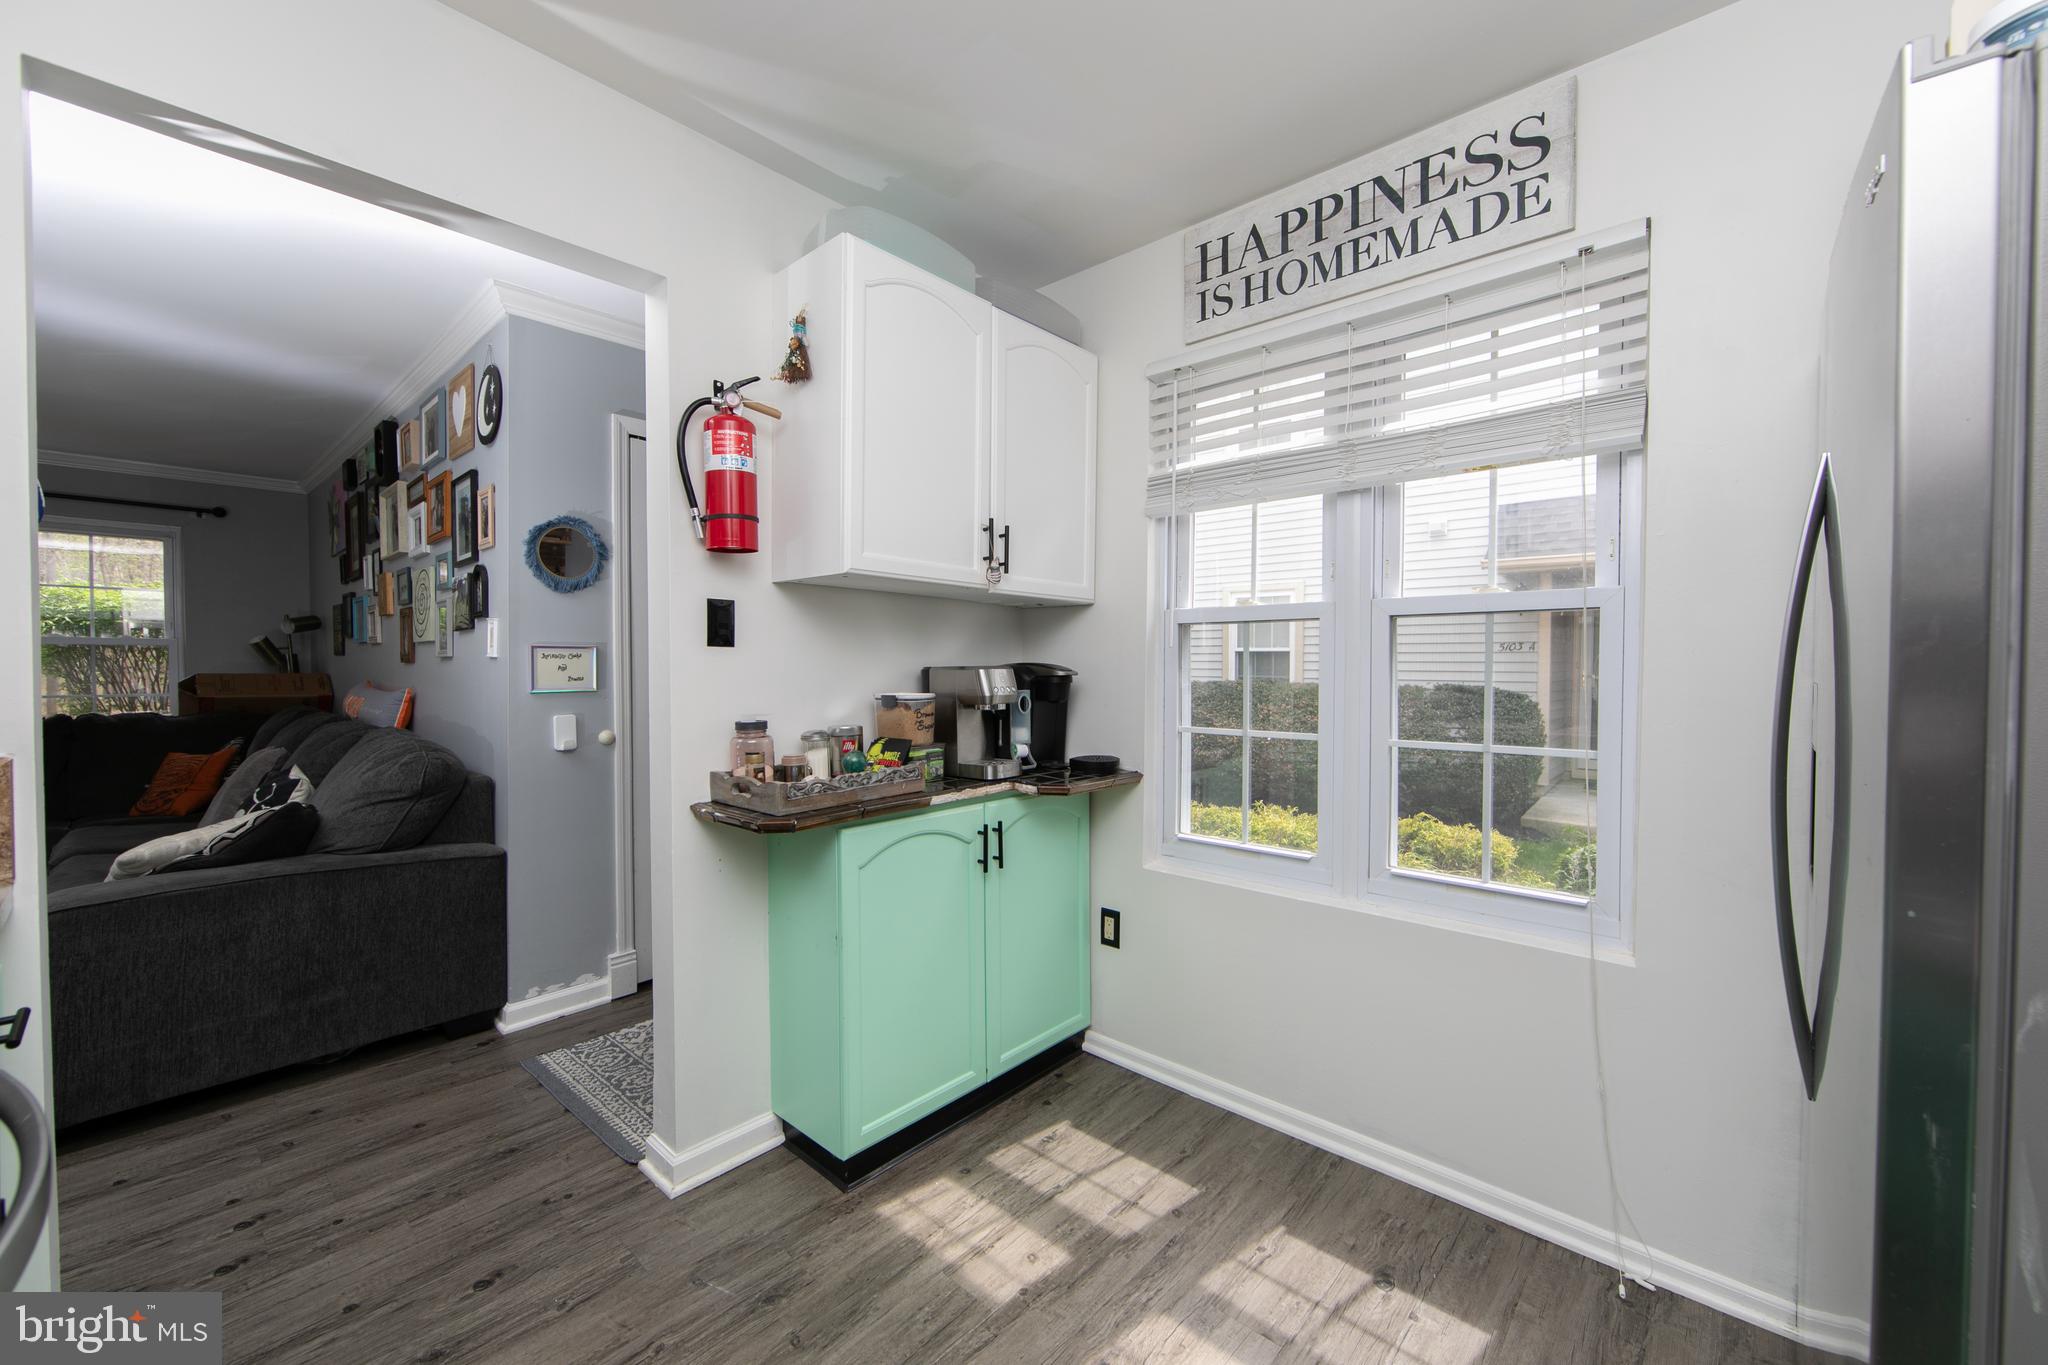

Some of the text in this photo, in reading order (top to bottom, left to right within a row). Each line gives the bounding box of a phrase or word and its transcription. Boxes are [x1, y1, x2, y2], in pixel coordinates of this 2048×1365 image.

[1195, 111, 1552, 285] HAPPINESS
[1196, 172, 1552, 324] IS HOMEMADE
